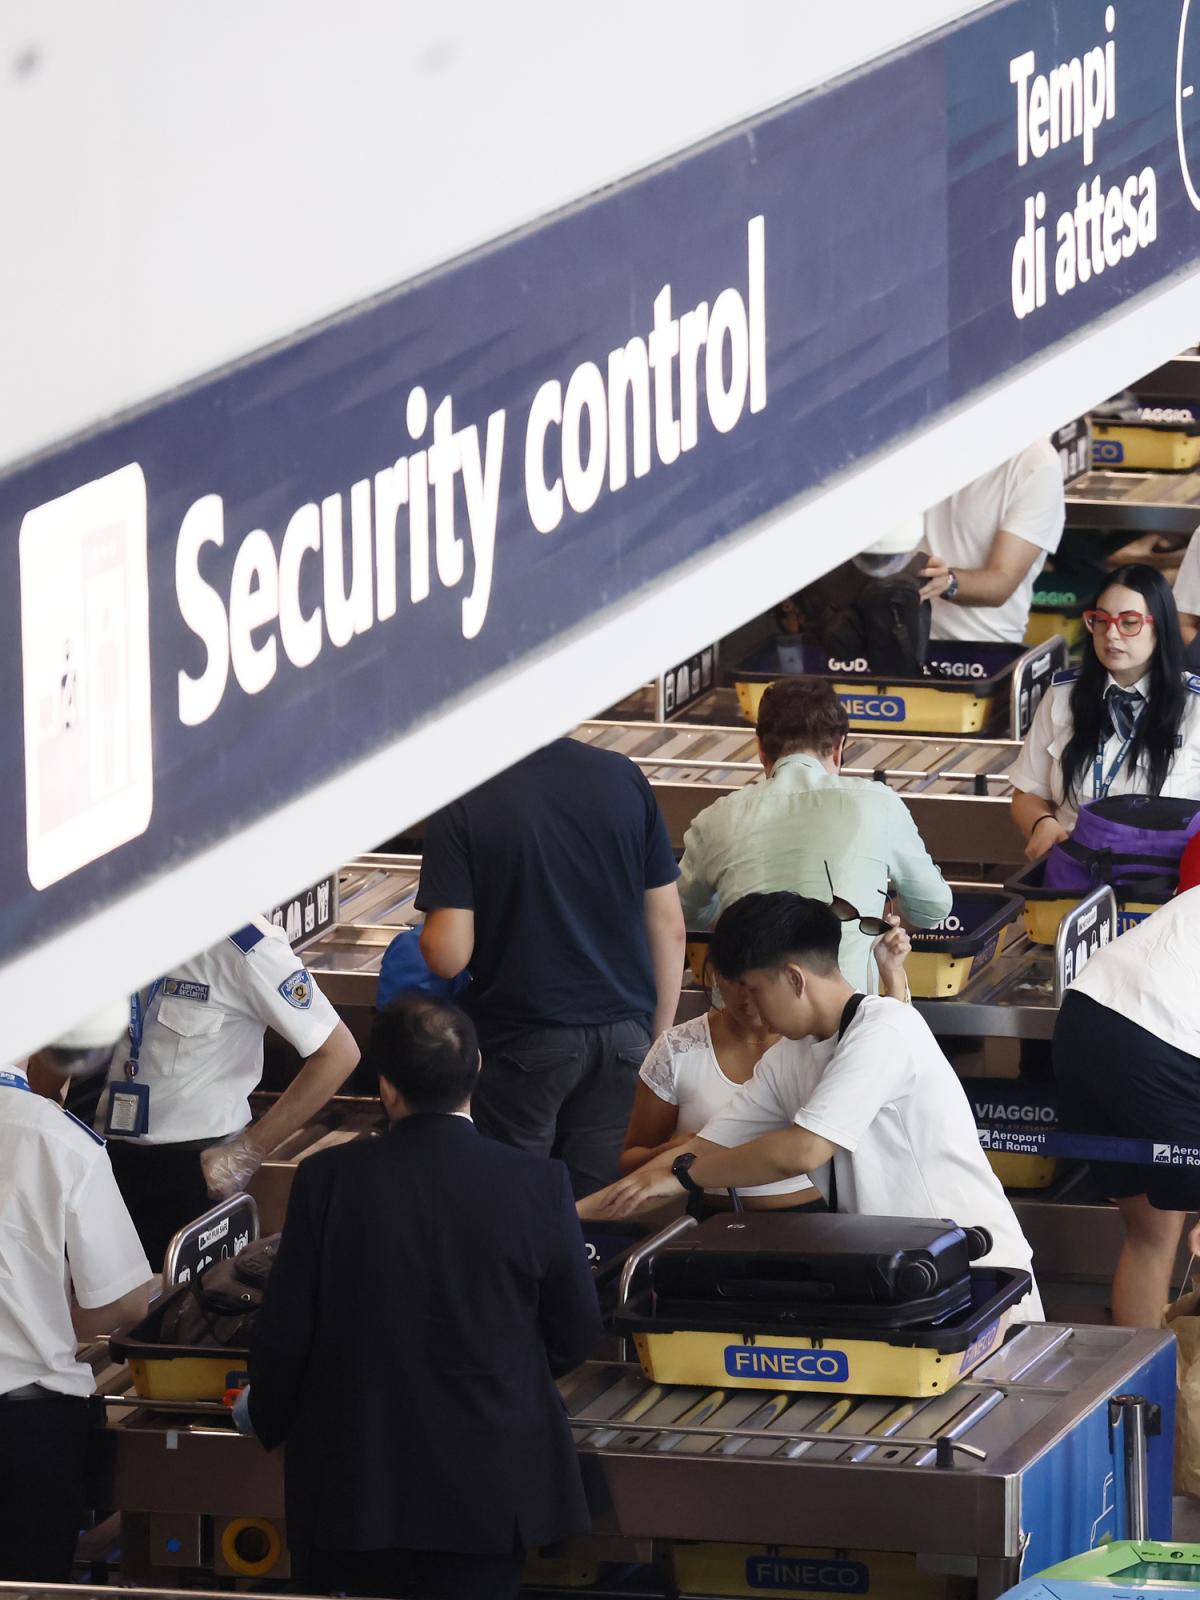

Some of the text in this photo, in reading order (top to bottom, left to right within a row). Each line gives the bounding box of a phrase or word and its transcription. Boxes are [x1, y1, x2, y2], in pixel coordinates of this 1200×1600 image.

[1010, 5, 1116, 167] Tempi
[1011, 166, 1157, 320] di attesa
[175, 215, 767, 726] Security control
[840, 699, 899, 717] NECO
[179, 989, 207, 1000] SECURITY
[180, 983, 208, 994] AIRPORT
[975, 1103, 1059, 1122] VIAGGIO.
[992, 1130, 1046, 1143] Aeroporti
[992, 1141, 1038, 1152] di Roma
[1172, 1154, 1182, 1164] di
[735, 1352, 839, 1376] FINECO
[756, 1563, 860, 1587] FINECO
